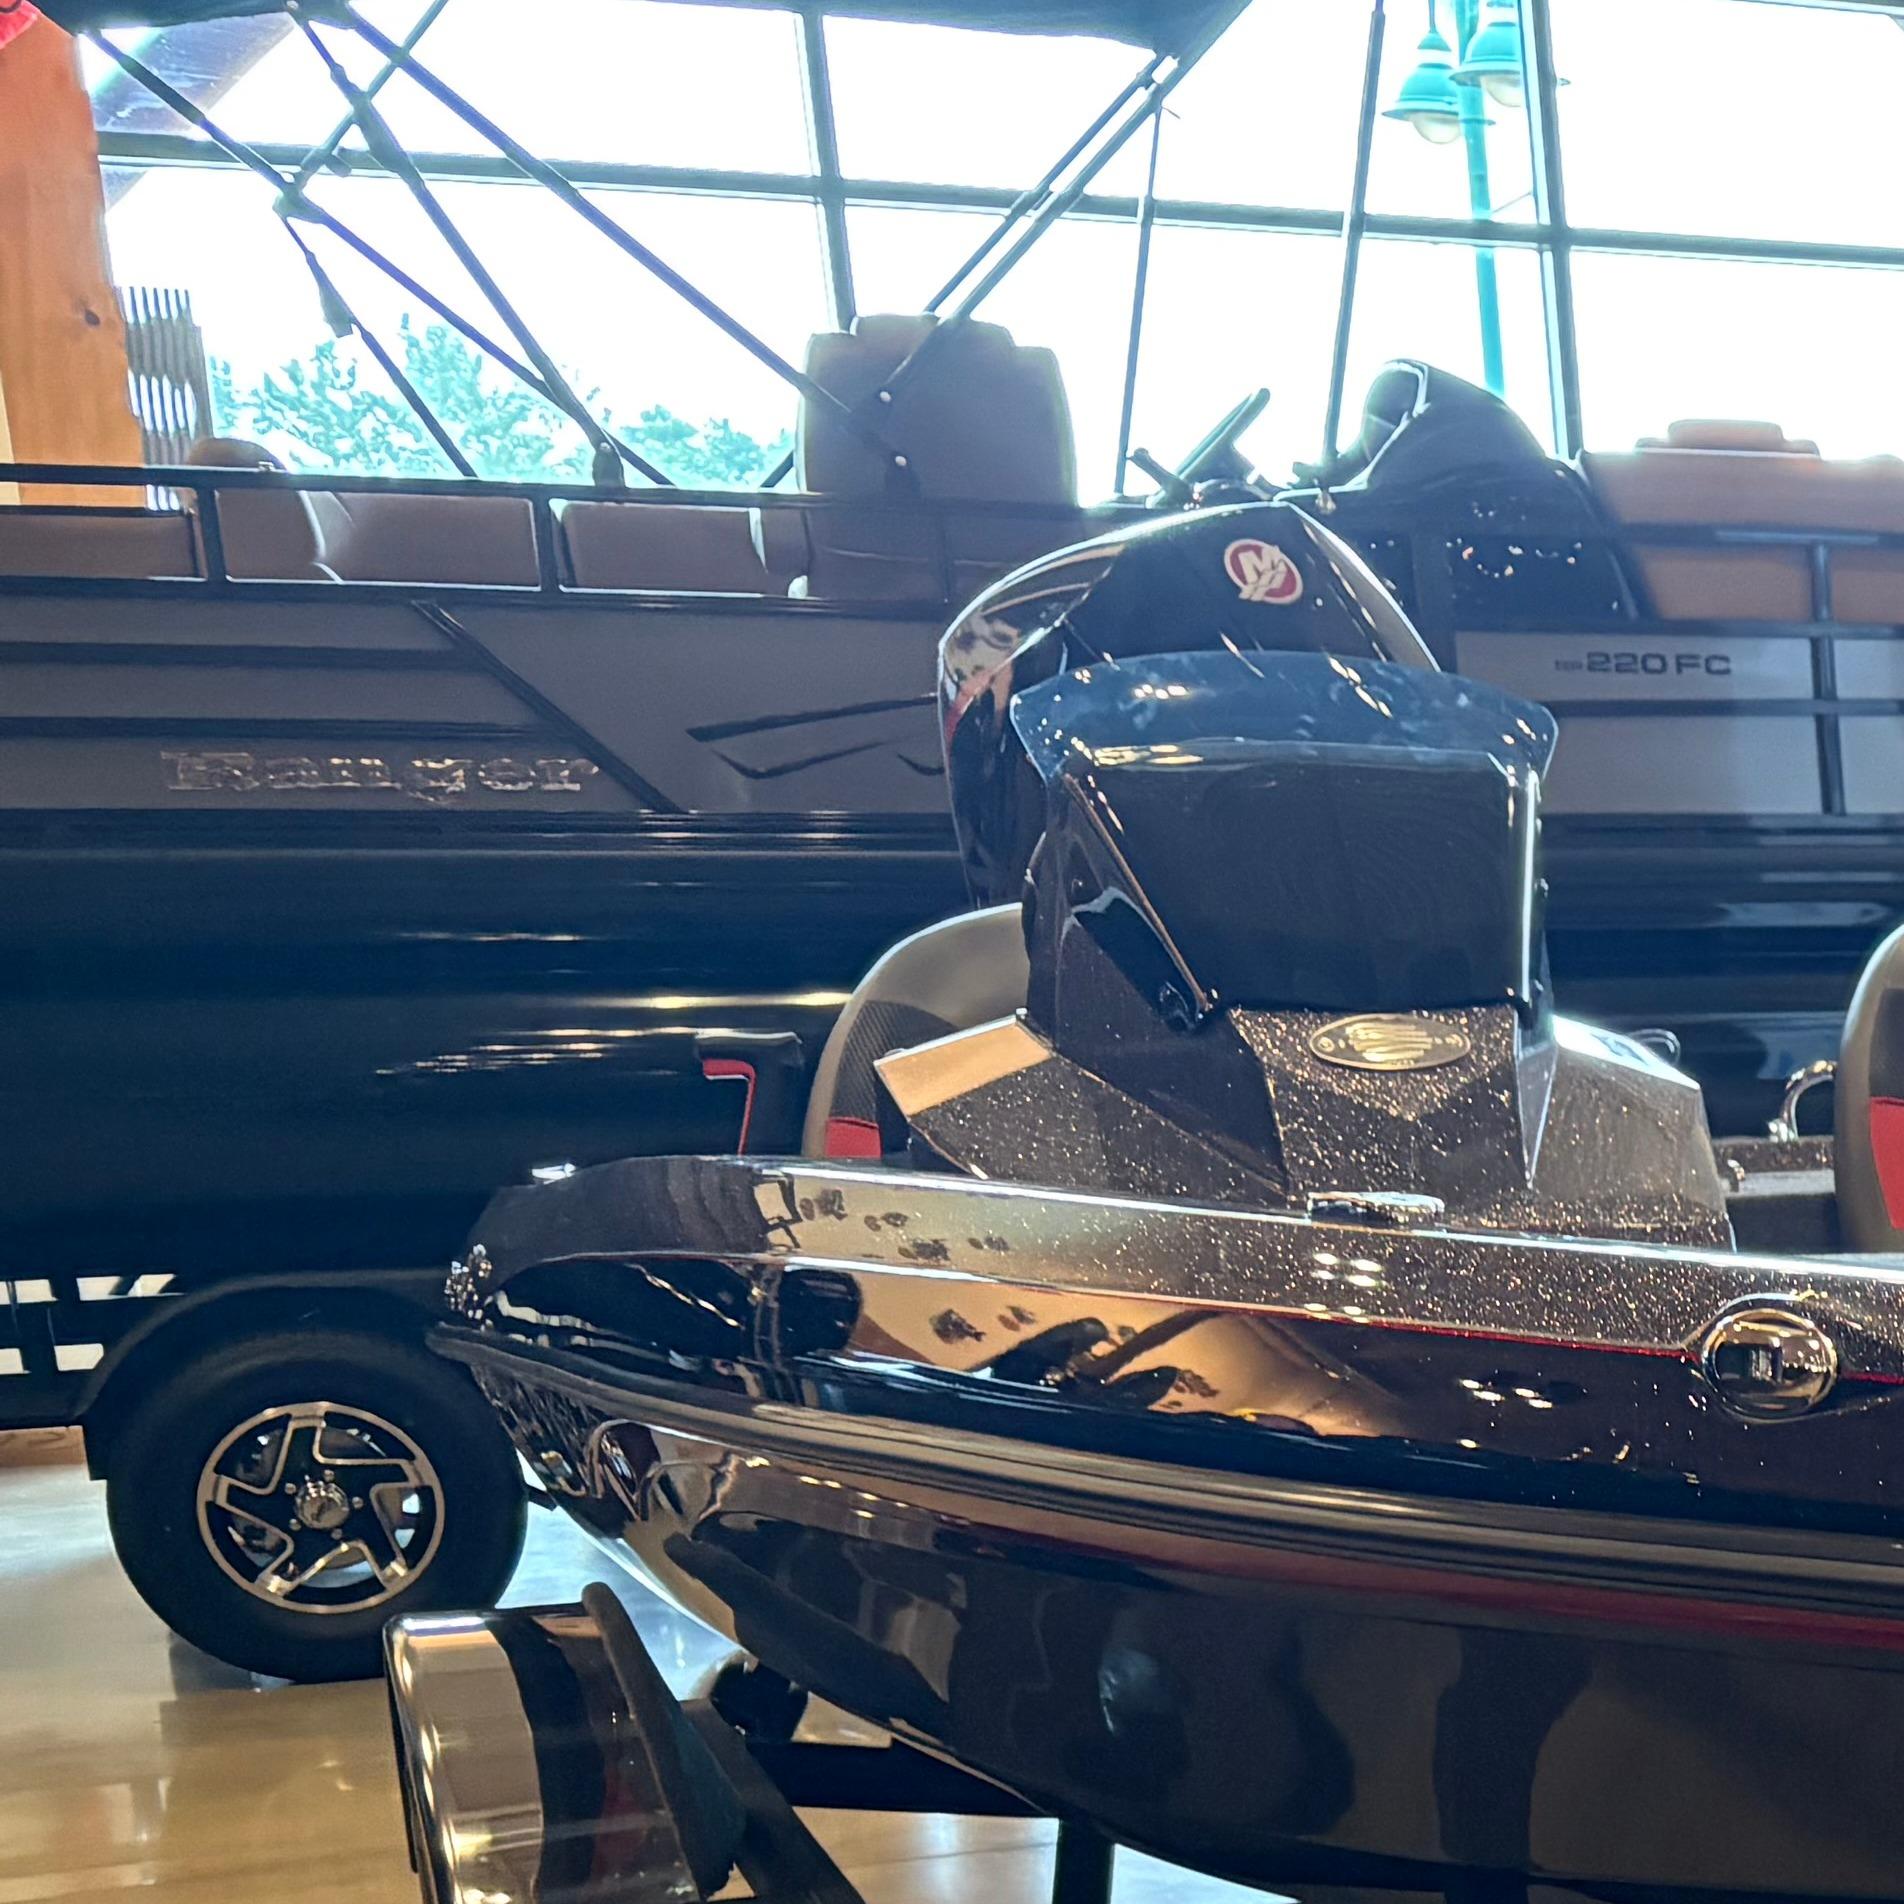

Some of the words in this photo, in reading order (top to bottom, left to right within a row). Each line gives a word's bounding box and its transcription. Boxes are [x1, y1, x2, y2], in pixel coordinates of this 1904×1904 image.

[1586, 651, 1668, 675] 220
[1675, 653, 1731, 676] FC
[160, 751, 599, 804] Ranger
